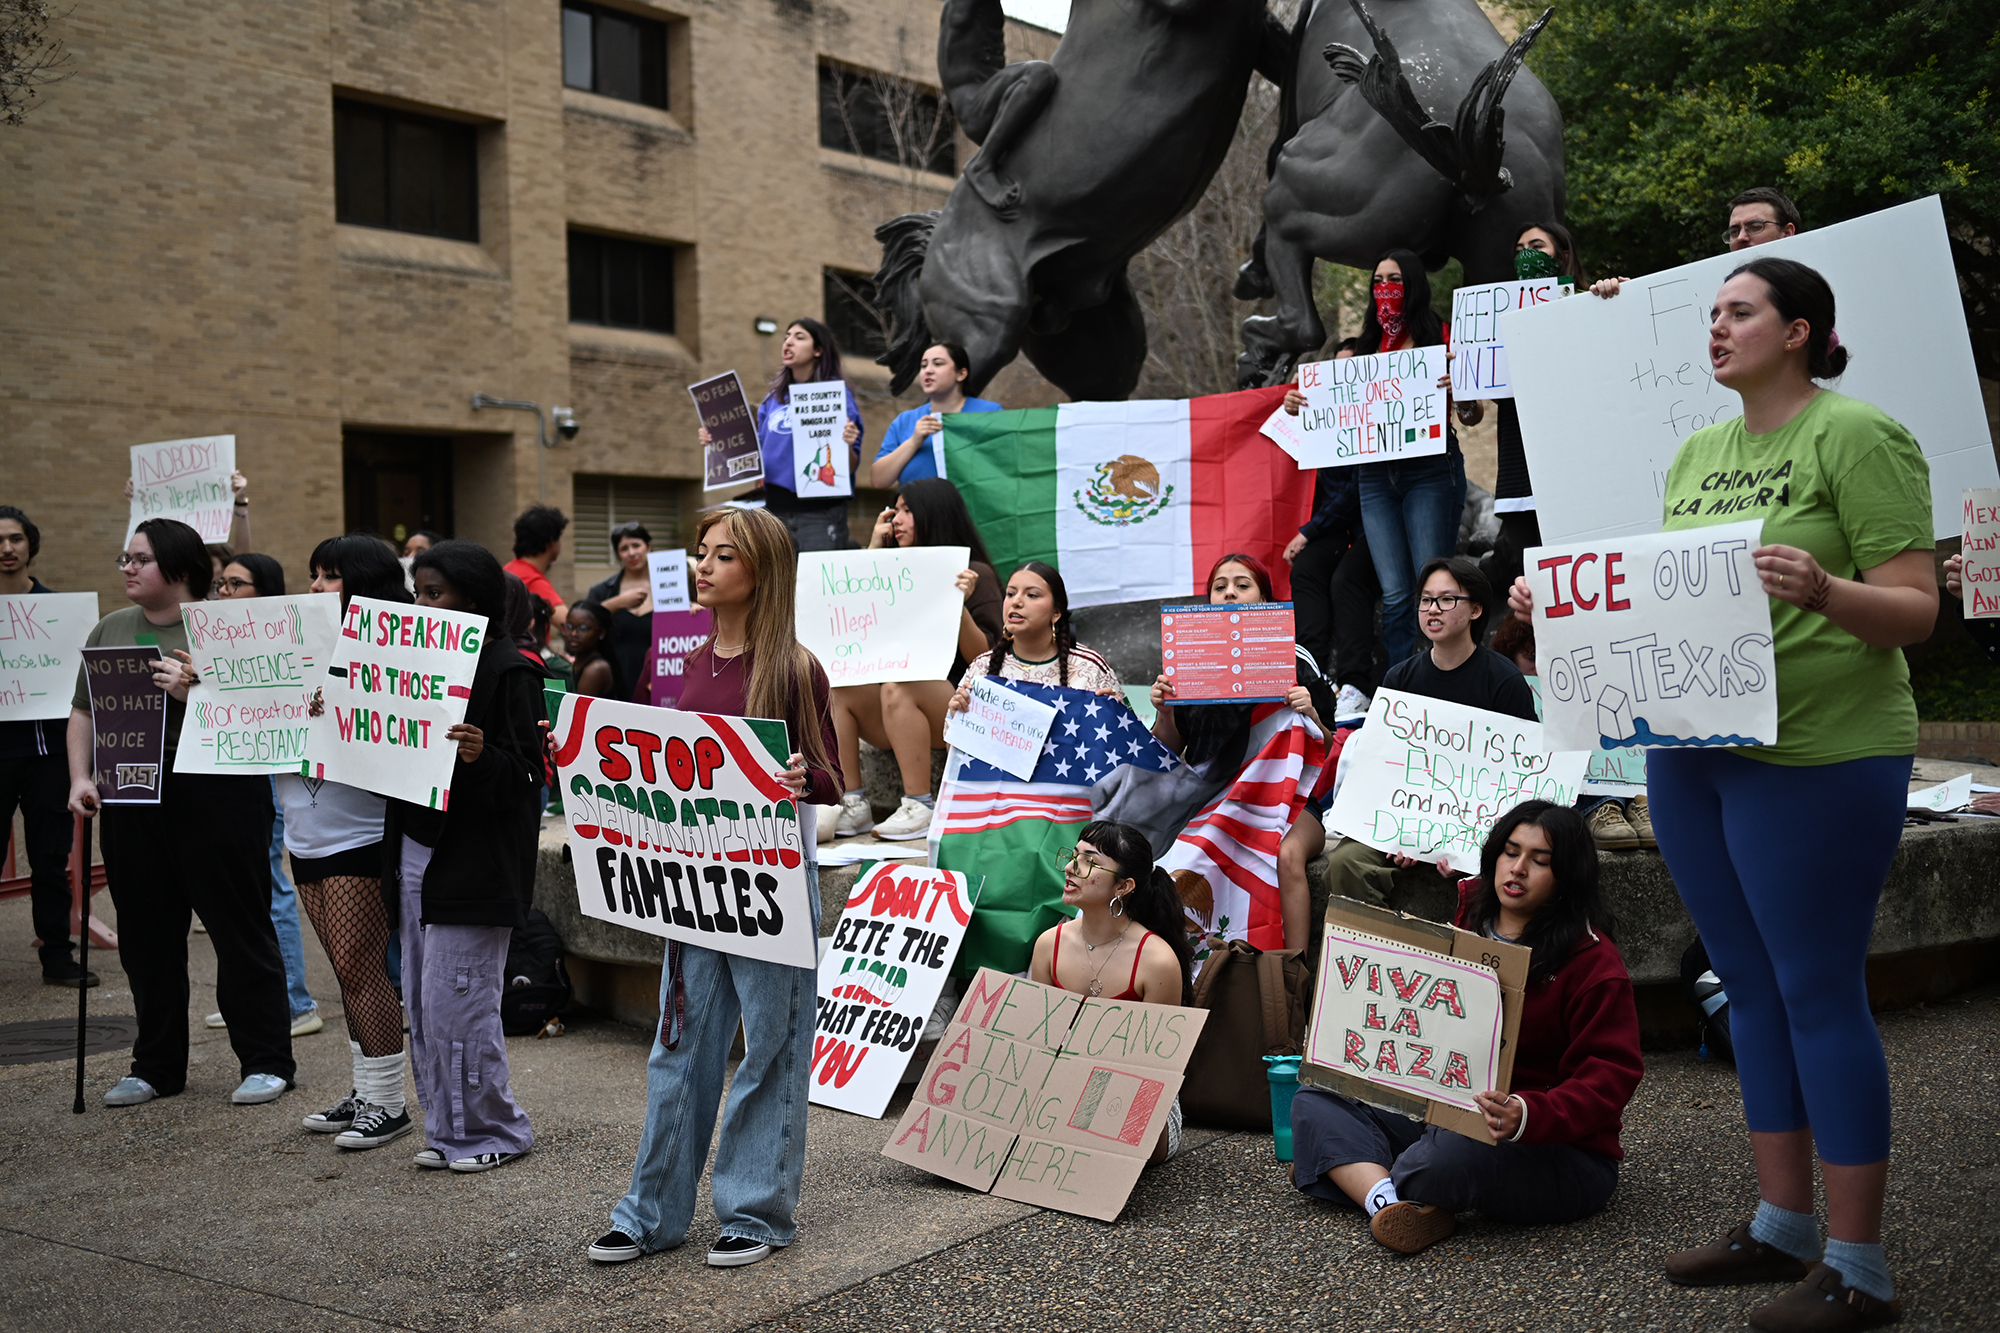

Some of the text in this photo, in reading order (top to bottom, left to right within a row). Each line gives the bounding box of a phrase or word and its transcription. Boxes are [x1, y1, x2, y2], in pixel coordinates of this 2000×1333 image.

[1452, 286, 1510, 345] KEEP
[1648, 278, 1713, 346] Fi
[1303, 348, 1428, 389] BE LOUD FOR
[1630, 358, 1714, 395] they
[695, 379, 739, 405] NO FEAR
[793, 390, 842, 402] THIS COUNTRY
[795, 402, 842, 415] WAS BUILD ON
[1328, 377, 1403, 405] THE ONES
[703, 404, 748, 429] NO HATE
[800, 416, 838, 427] IMMIGRANT
[1303, 393, 1436, 432] WHO HAVE TO BE
[1662, 399, 1730, 438] for
[706, 432, 746, 455] NO ICE
[808, 429, 832, 439] LABOR
[1336, 420, 1403, 459] SILENT!
[706, 454, 760, 480] AT TXST
[144, 480, 223, 514] is illegal on
[1671, 482, 1790, 517] LA MIGRA
[821, 557, 914, 607] Nobody is
[1537, 538, 1748, 619] ICE OUT
[1972, 587, 2000, 614] AN
[264, 618, 288, 640] our
[376, 610, 481, 654] SPEAKING
[827, 601, 879, 642] illegal
[86, 659, 113, 676] NO
[212, 651, 303, 685] EXISTENCE
[834, 641, 863, 658] on
[877, 652, 910, 671] Land
[1549, 632, 1773, 704] OF TEXAS
[349, 660, 446, 701] FOR THOSE
[969, 679, 1016, 712] Nadie es
[93, 694, 163, 712] NO HATE
[240, 699, 281, 729] expect
[283, 702, 306, 720] our
[96, 731, 146, 749] NO ICE
[335, 705, 432, 750] WHO CANT
[959, 713, 1033, 753] tierra ROBADA
[1010, 719, 1044, 740] en una
[1392, 699, 1543, 770] School is for
[96, 765, 157, 786] AT TXST
[595, 724, 725, 791] STOP
[1584, 754, 1630, 779] GAL
[1405, 748, 1575, 808] EDUCATION
[570, 773, 801, 870] SEPARATING
[1391, 788, 1433, 813] and
[1437, 800, 1473, 821] not
[1371, 809, 1489, 858] DEPORTA
[596, 846, 784, 937] FAMILIES
[870, 875, 956, 923] DON'T
[832, 917, 950, 970] BITE THE
[831, 956, 908, 1008] HAND
[1334, 954, 1467, 1019] VIVA
[860, 1009, 924, 1053] FEEDS
[959, 970, 1187, 1060] MEXICANS
[1364, 1001, 1422, 1039] LA
[810, 1035, 870, 1090] YOU
[1343, 1027, 1473, 1090] RAZA
[926, 1060, 1062, 1133] GOING
[894, 1105, 1091, 1195] ANYWHERE
